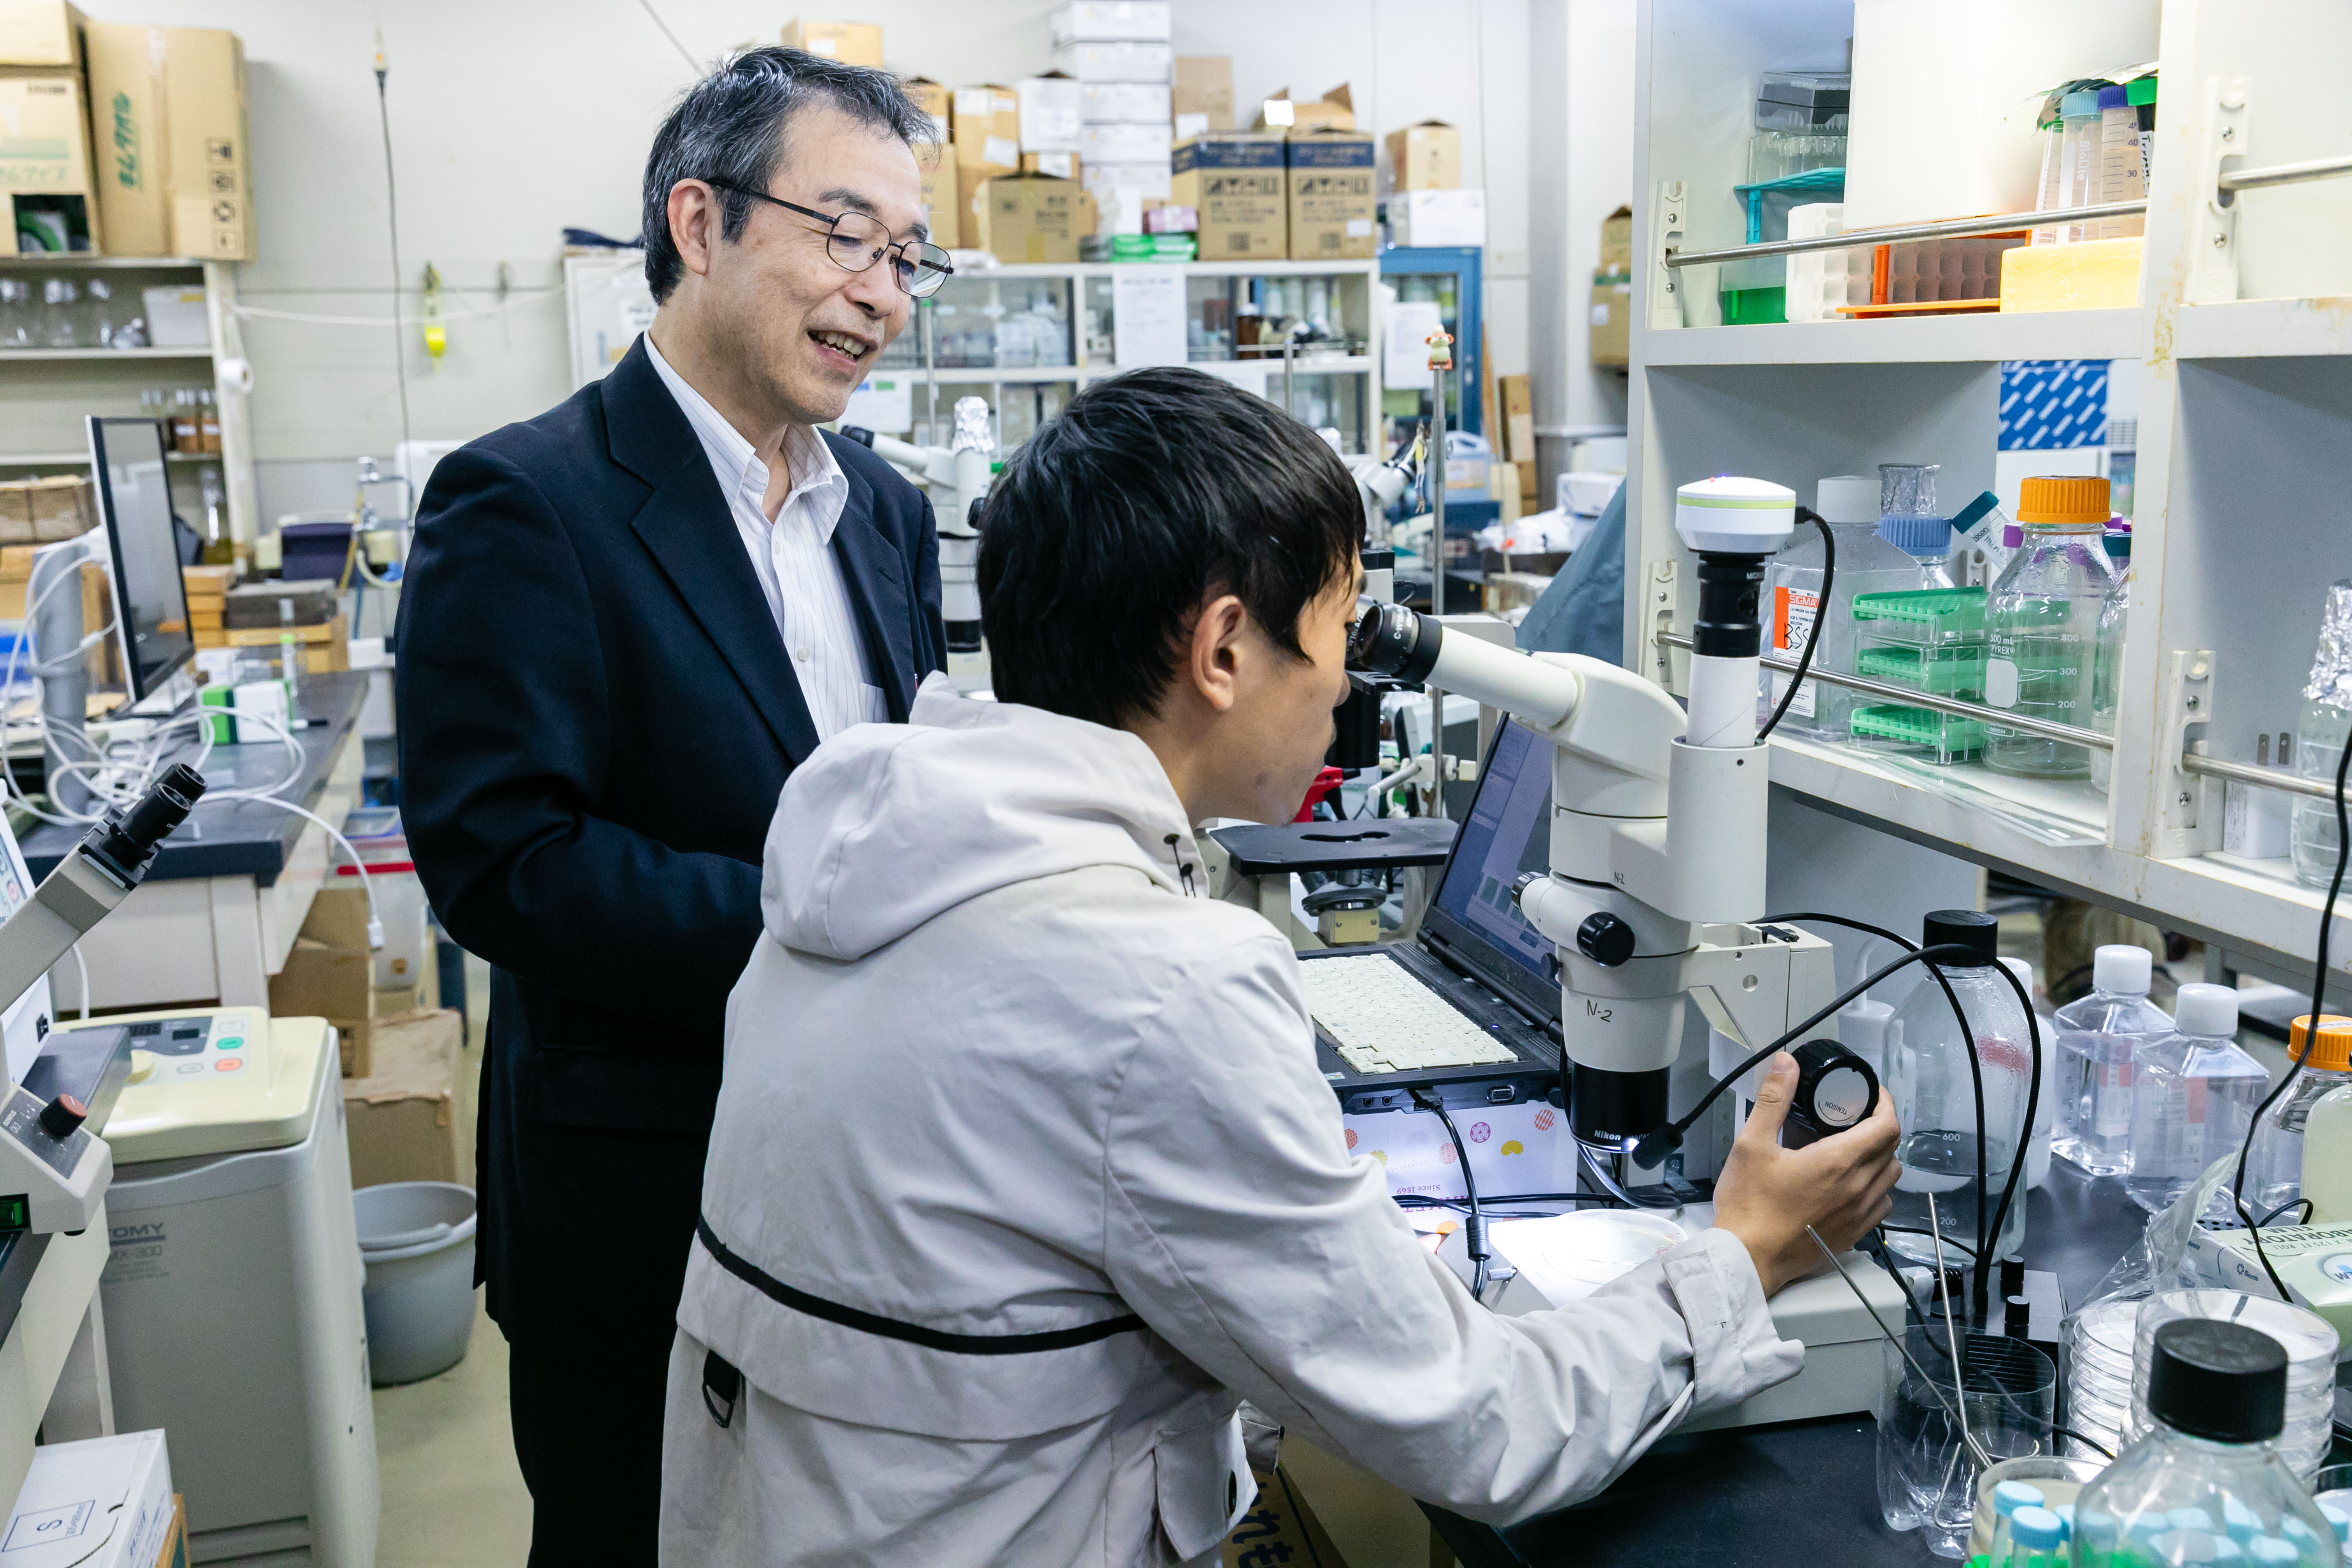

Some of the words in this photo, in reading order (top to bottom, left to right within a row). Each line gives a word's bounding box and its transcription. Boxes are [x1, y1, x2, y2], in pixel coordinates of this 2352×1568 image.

[2077, 141, 2090, 181] BioLite
[1990, 634, 2002, 643] 500
[1614, 872, 1625, 884] N-2
[1587, 999, 1612, 1023] N-2
[1824, 1101, 1847, 1115] TENSION
[1594, 1130, 1621, 1140] Nikon
[1942, 1133, 1960, 1141] 600
[37, 1519, 63, 1531] S
